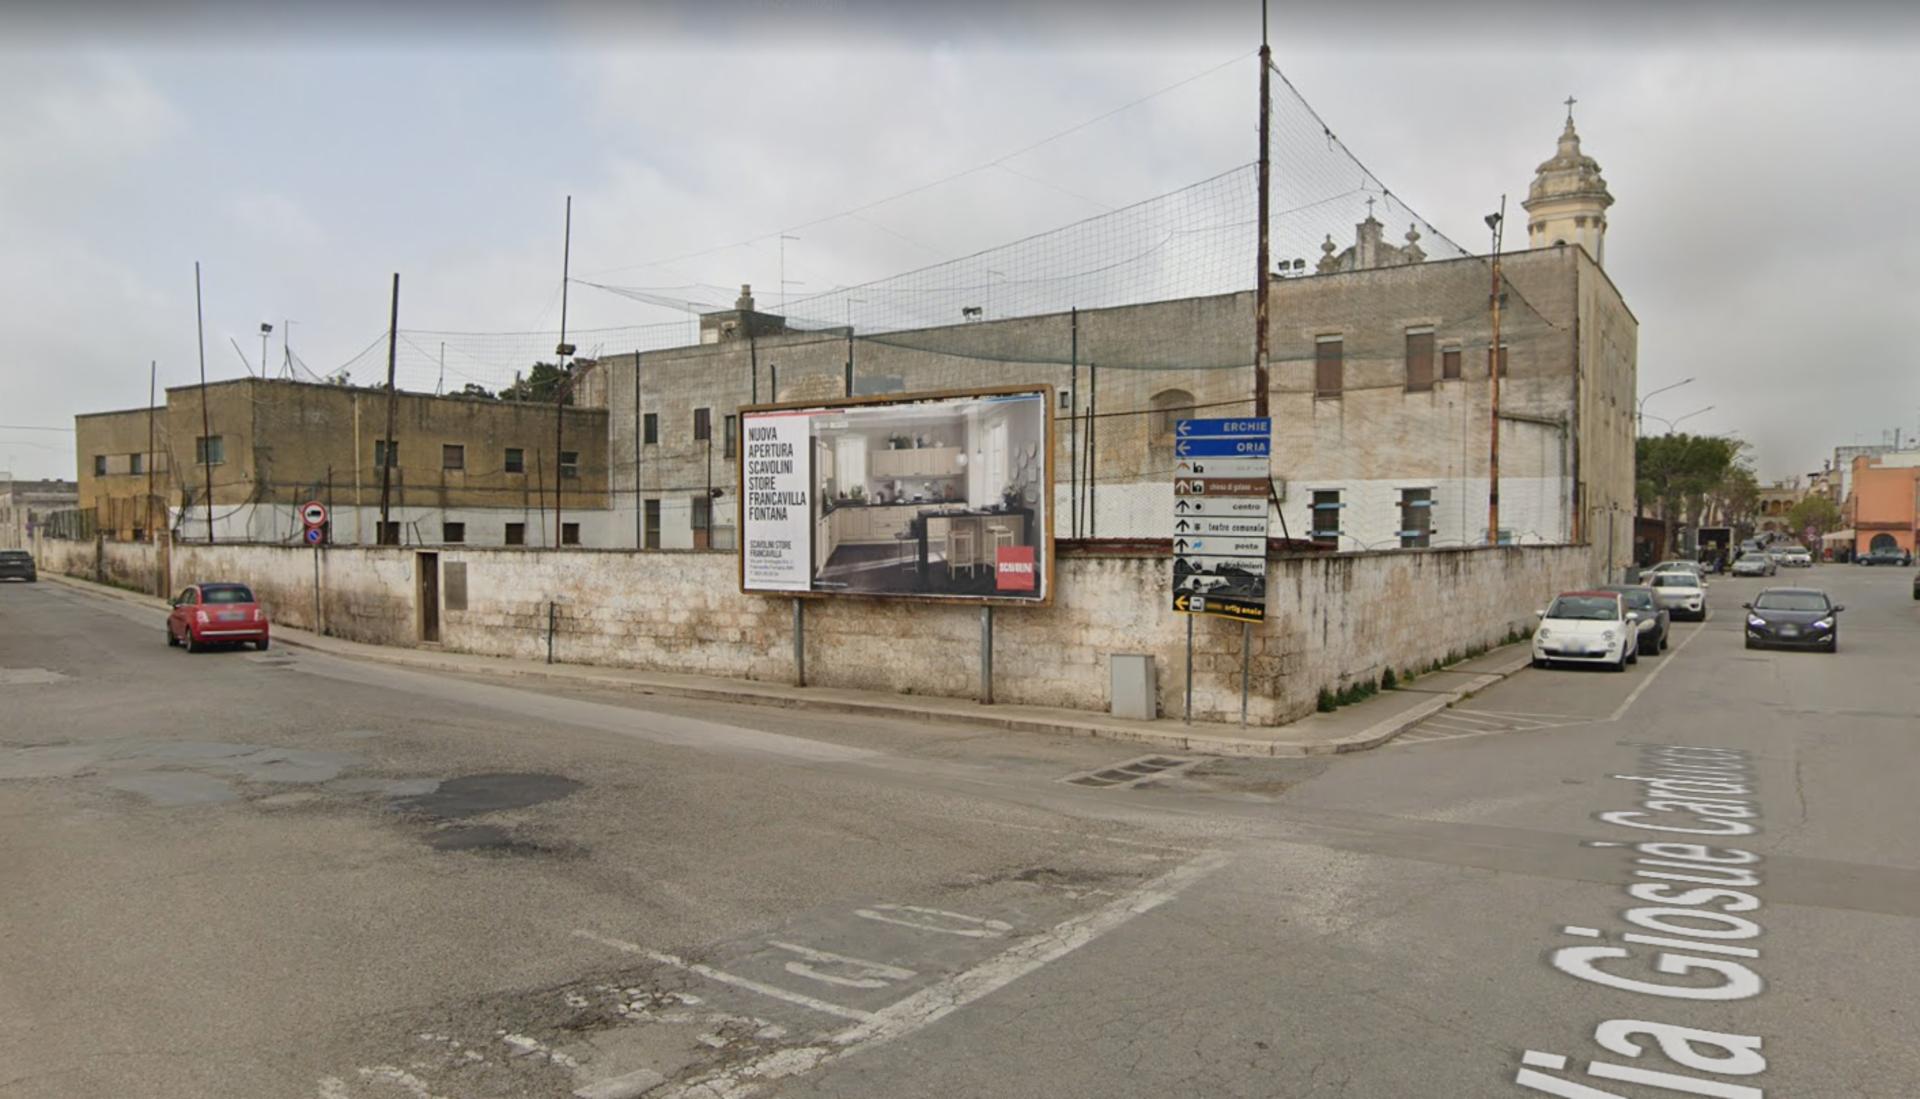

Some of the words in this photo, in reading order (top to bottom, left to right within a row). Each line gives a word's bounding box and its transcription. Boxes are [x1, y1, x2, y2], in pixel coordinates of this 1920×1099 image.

[1223, 421, 1268, 432] ERCHIE
[748, 427, 777, 441] NUOVA
[748, 443, 794, 458] APERTURA
[1236, 442, 1266, 452] ORIA
[748, 460, 793, 475] SCAVOLINI
[748, 476, 776, 490] STORE
[748, 491, 807, 506] FRANCAVILLA
[1232, 503, 1261, 511] centro
[748, 507, 788, 521] FONTANA
[1208, 523, 1229, 531] teatro
[1231, 523, 1265, 532] comunale
[750, 540, 774, 549] SCAVOLINI
[775, 540, 792, 550] STORE
[750, 549, 782, 558] FRANCAVILLA
